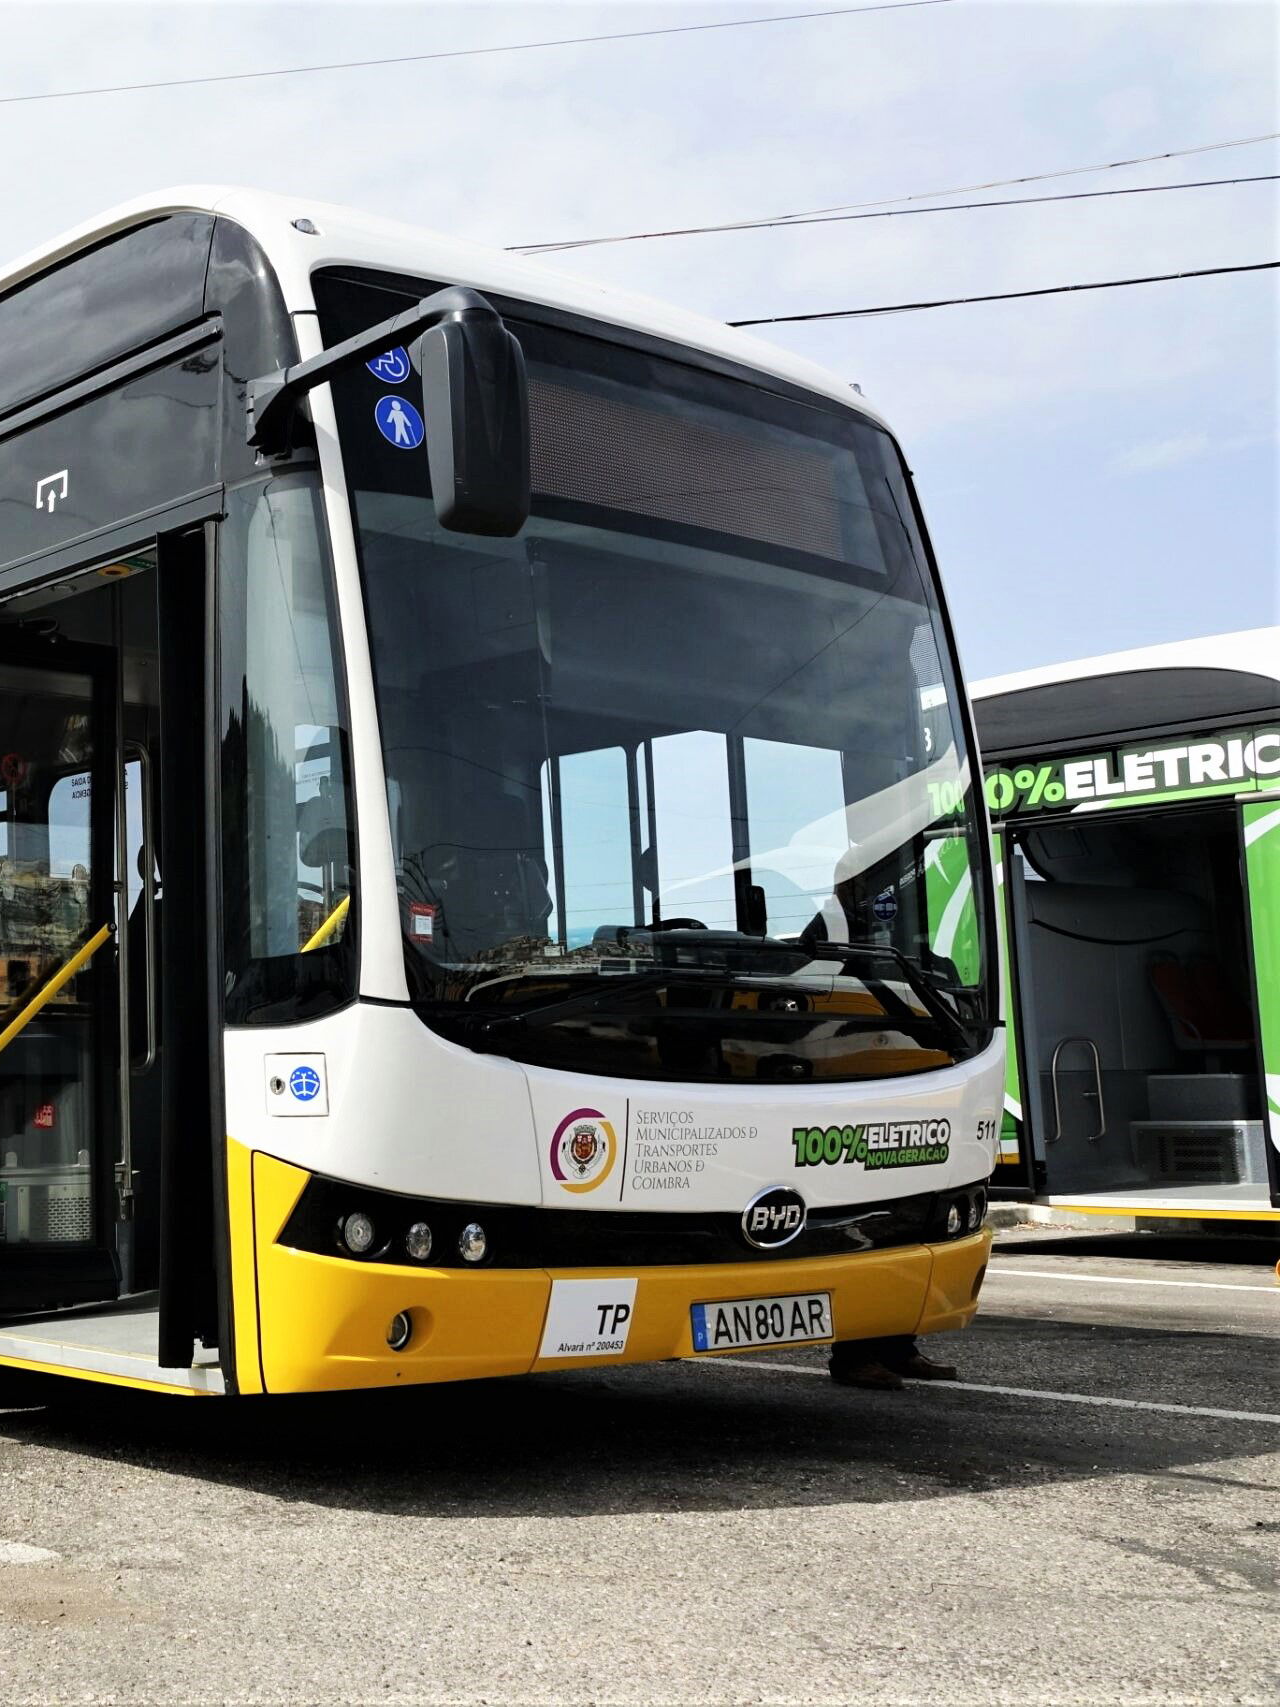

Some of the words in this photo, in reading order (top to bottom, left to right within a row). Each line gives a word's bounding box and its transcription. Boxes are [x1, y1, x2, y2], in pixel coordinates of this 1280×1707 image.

[636, 1110, 694, 1127] SERVIÇOS
[636, 1127, 746, 1141] MUNICIPALIZADOS
[976, 1120, 996, 1140] 511
[636, 1143, 718, 1157] TRANSPORTES
[794, 1125, 868, 1163] 100%
[634, 1160, 693, 1174] URBANOS
[632, 1175, 690, 1190] COIMBRA
[750, 1204, 801, 1231] BYD
[597, 1304, 630, 1335] TP
[557, 1341, 584, 1352] Alvará
[596, 1340, 624, 1350] 200453
